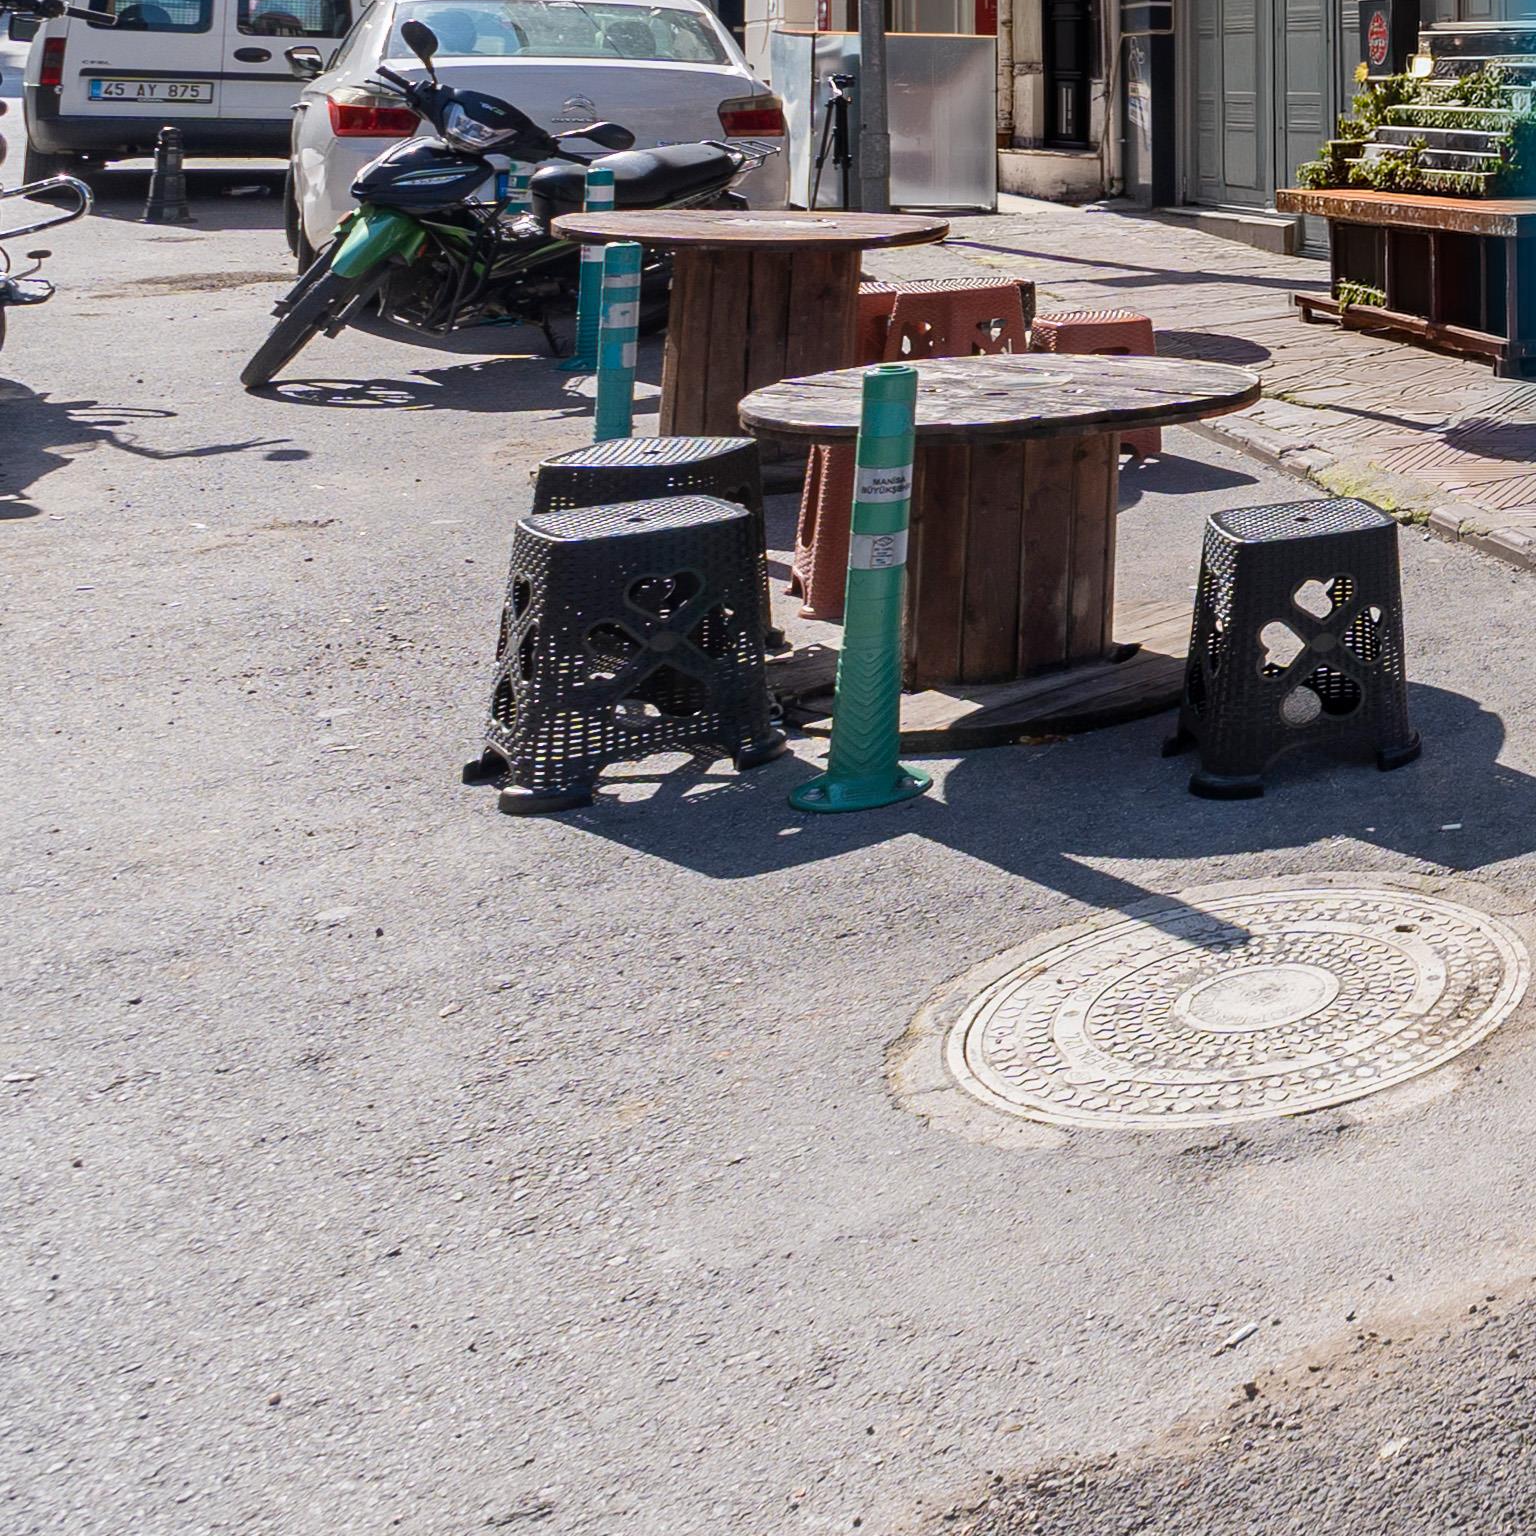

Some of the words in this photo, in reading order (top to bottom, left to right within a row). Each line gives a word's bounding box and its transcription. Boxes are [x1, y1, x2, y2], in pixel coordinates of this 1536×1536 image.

[104, 83, 125, 97] 45
[137, 84, 157, 97] AY
[168, 84, 201, 98] 875
